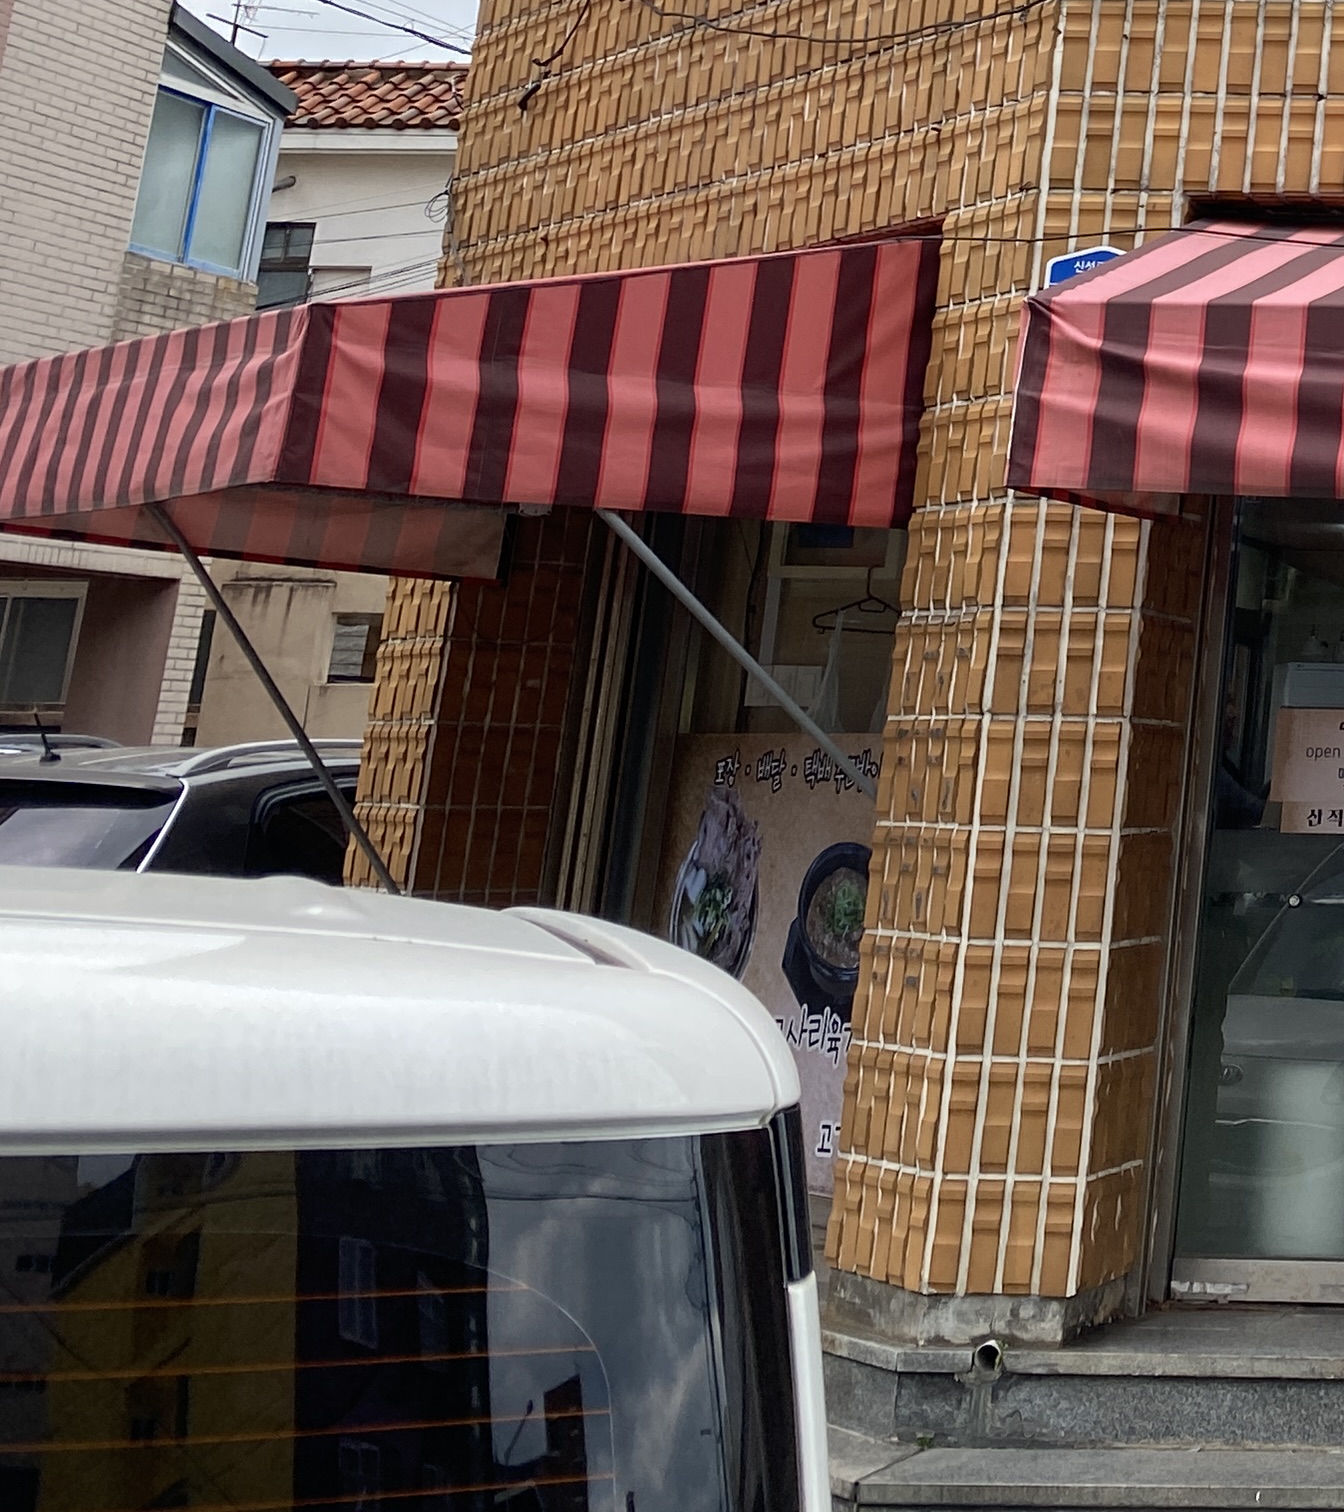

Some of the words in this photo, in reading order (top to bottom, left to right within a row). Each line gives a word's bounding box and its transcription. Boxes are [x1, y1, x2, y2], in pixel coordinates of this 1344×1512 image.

[1305, 745, 1342, 761] open
[715, 748, 741, 787] 포장
[757, 748, 787, 793] 배달
